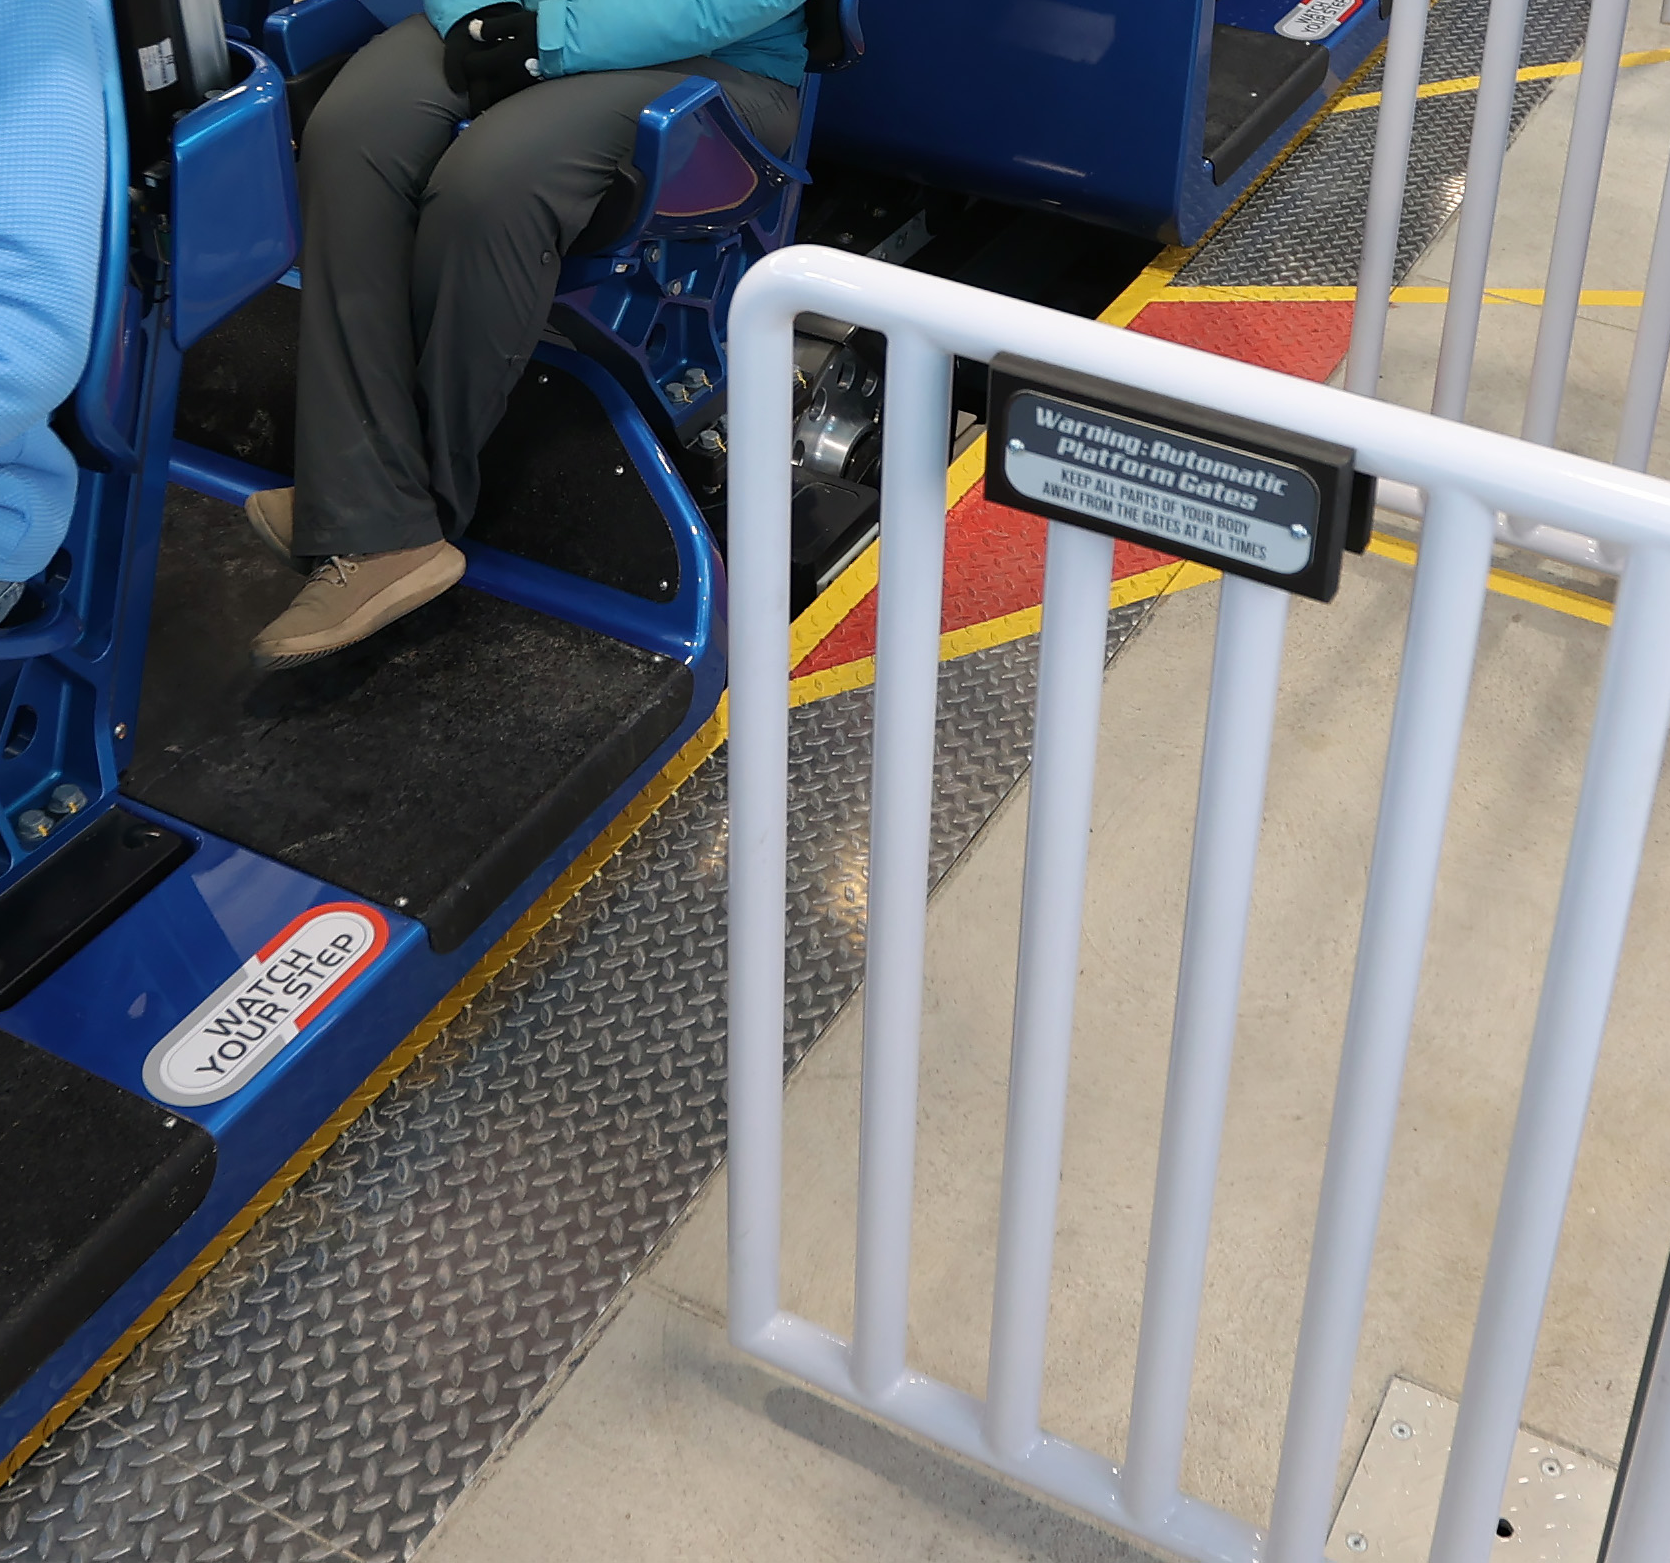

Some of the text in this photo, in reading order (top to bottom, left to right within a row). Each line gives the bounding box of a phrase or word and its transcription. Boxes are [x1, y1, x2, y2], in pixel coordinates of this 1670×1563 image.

[1294, 0, 1329, 25] WATCH
[1301, 14, 1331, 34] YOUR
[1035, 406, 1289, 496] Warning: Automatic
[1056, 436, 1258, 511] Platform Gates
[1043, 481, 1267, 559] AWAY FROM THE GATES AT ALL TIMES
[1061, 469, 1250, 536] KEEP ALL PARTS OF YOUR BODY
[194, 933, 354, 1077] YOUR STEP
[203, 947, 313, 1039] WATCH
